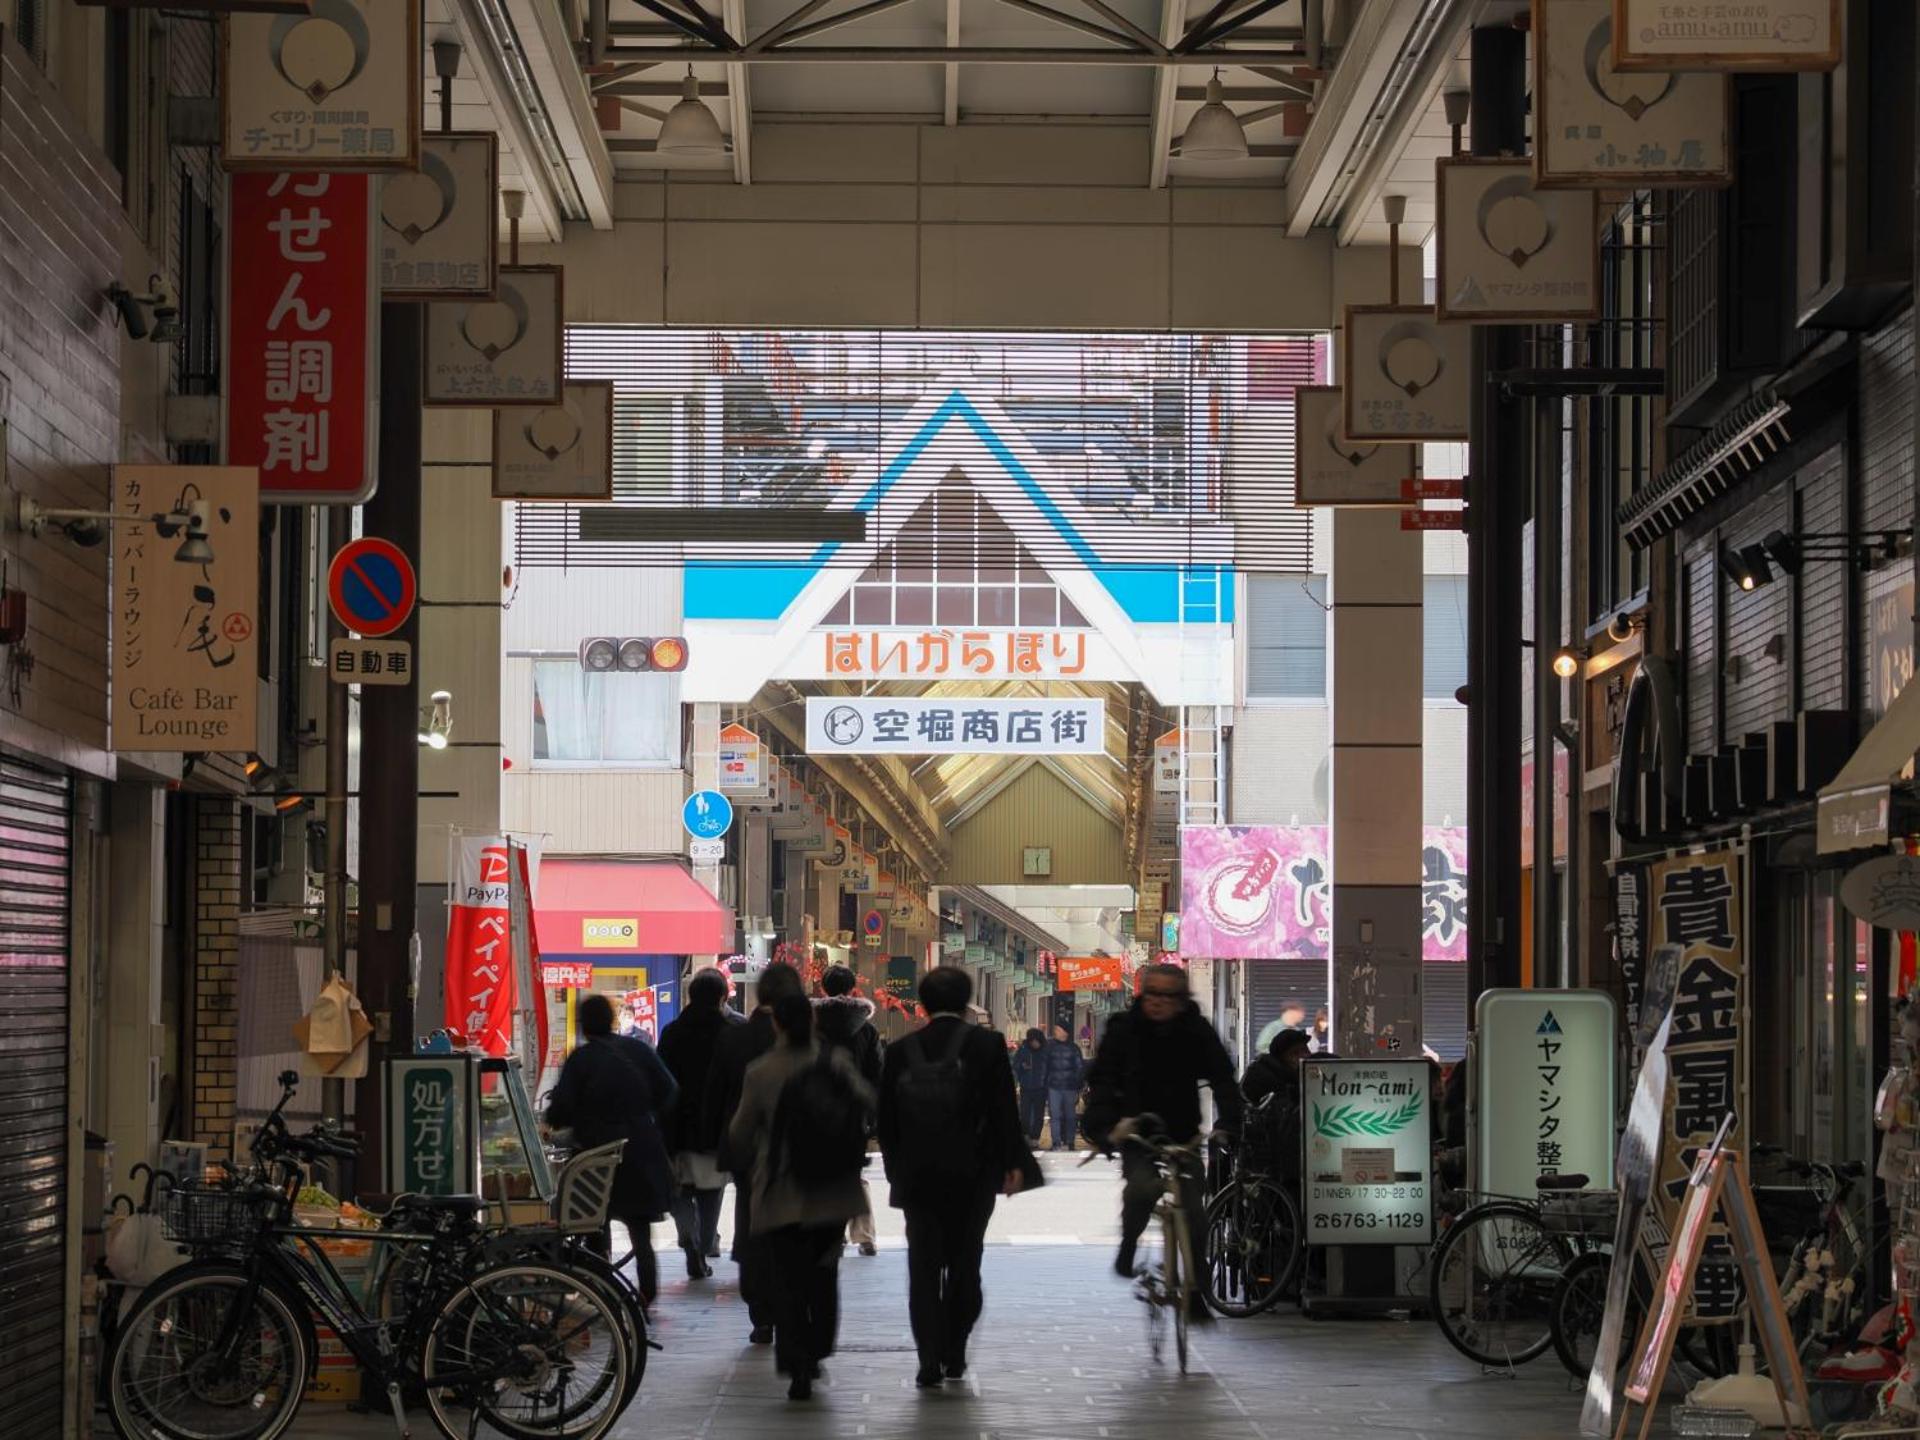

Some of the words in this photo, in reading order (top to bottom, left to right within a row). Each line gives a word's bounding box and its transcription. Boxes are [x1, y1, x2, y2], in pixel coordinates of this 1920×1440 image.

[243, 127, 395, 154] チェリー薬局
[336, 650, 408, 675] 自動車
[129, 687, 184, 711] Café
[195, 688, 238, 710] Bar
[138, 714, 229, 740] Lounge
[872, 708, 1088, 744] 空堀商店街
[1331, 1213, 1425, 1229] 6763-1129
